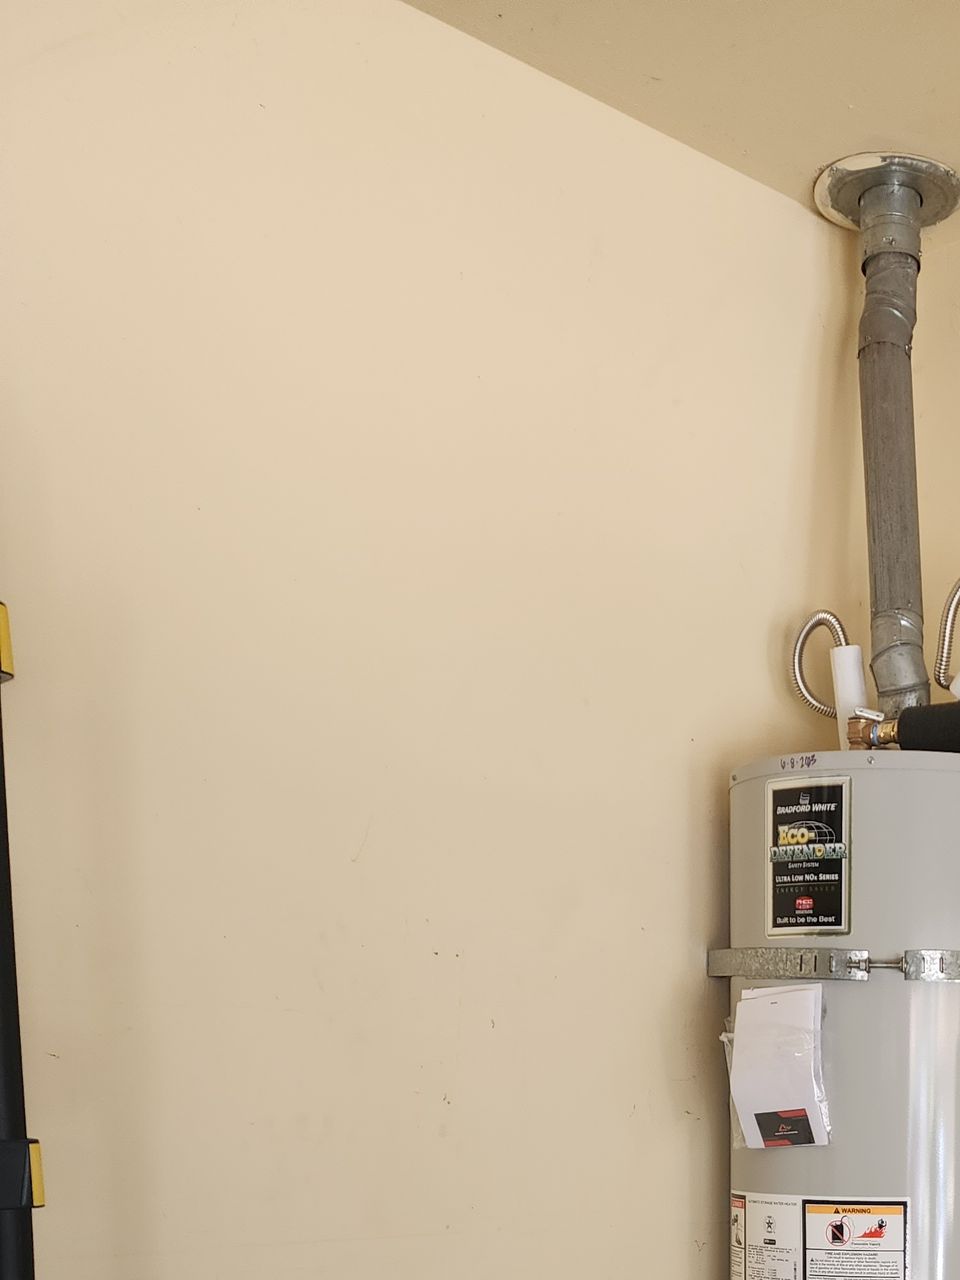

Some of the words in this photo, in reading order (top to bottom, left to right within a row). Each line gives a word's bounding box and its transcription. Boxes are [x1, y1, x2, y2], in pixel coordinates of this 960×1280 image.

[776, 805, 811, 815] BRADFORD
[811, 803, 836, 812] WHITE
[770, 843, 847, 862] DEFENDER
[775, 875, 791, 883] ULTRA
[791, 874, 804, 882] LOW
[806, 915, 818, 923] the
[818, 915, 836, 923] Best
